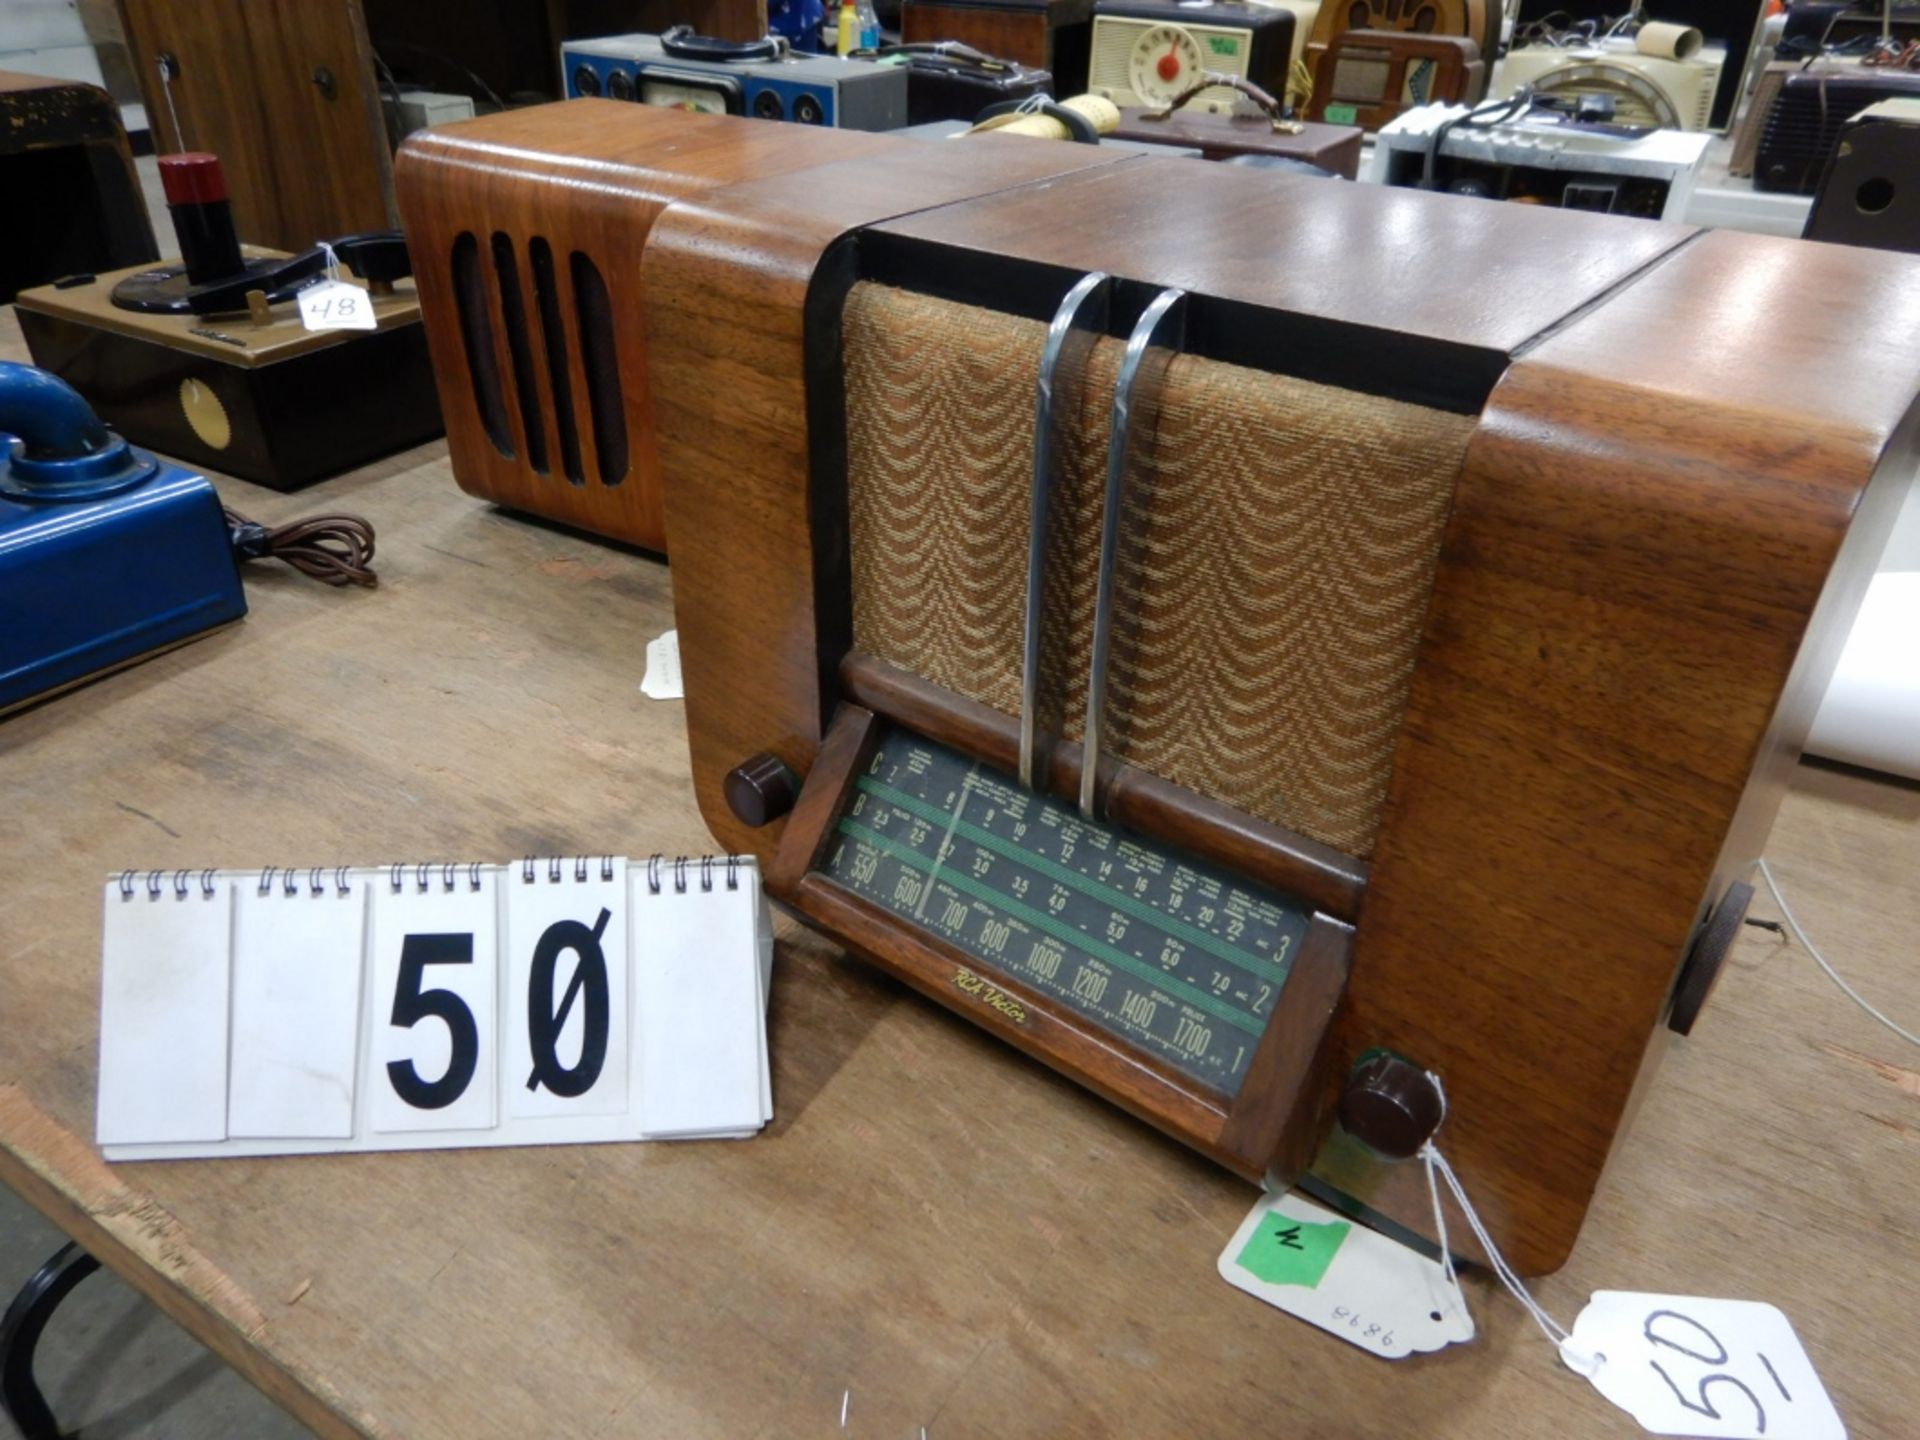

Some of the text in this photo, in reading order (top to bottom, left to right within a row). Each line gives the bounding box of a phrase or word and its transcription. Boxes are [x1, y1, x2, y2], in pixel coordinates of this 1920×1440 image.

[311, 298, 356, 319] 48
[1011, 875, 1029, 894] 3.5
[1049, 894, 1066, 912] 4.0
[1107, 921, 1125, 940] 5.0
[1160, 948, 1180, 967] 6.0
[1211, 971, 1231, 991] 7.0
[1252, 984, 1271, 1014] 2
[1013, 822, 1027, 837] 10
[1061, 844, 1075, 860] 12
[1099, 860, 1113, 876] 14
[1134, 876, 1149, 893] 16
[1169, 892, 1184, 909] 18
[1198, 906, 1216, 923] 20
[1227, 919, 1245, 938] 22
[1273, 935, 1291, 962] 3
[851, 854, 877, 884] 550
[894, 876, 921, 907] 600
[942, 900, 968, 930] 700
[979, 919, 1010, 952] 800
[1027, 943, 1062, 979] 1000
[1072, 965, 1108, 1003] 1200
[1119, 990, 1156, 1028] 1400
[1173, 1016, 1212, 1056] 1700
[1231, 1047, 1245, 1074] 1
